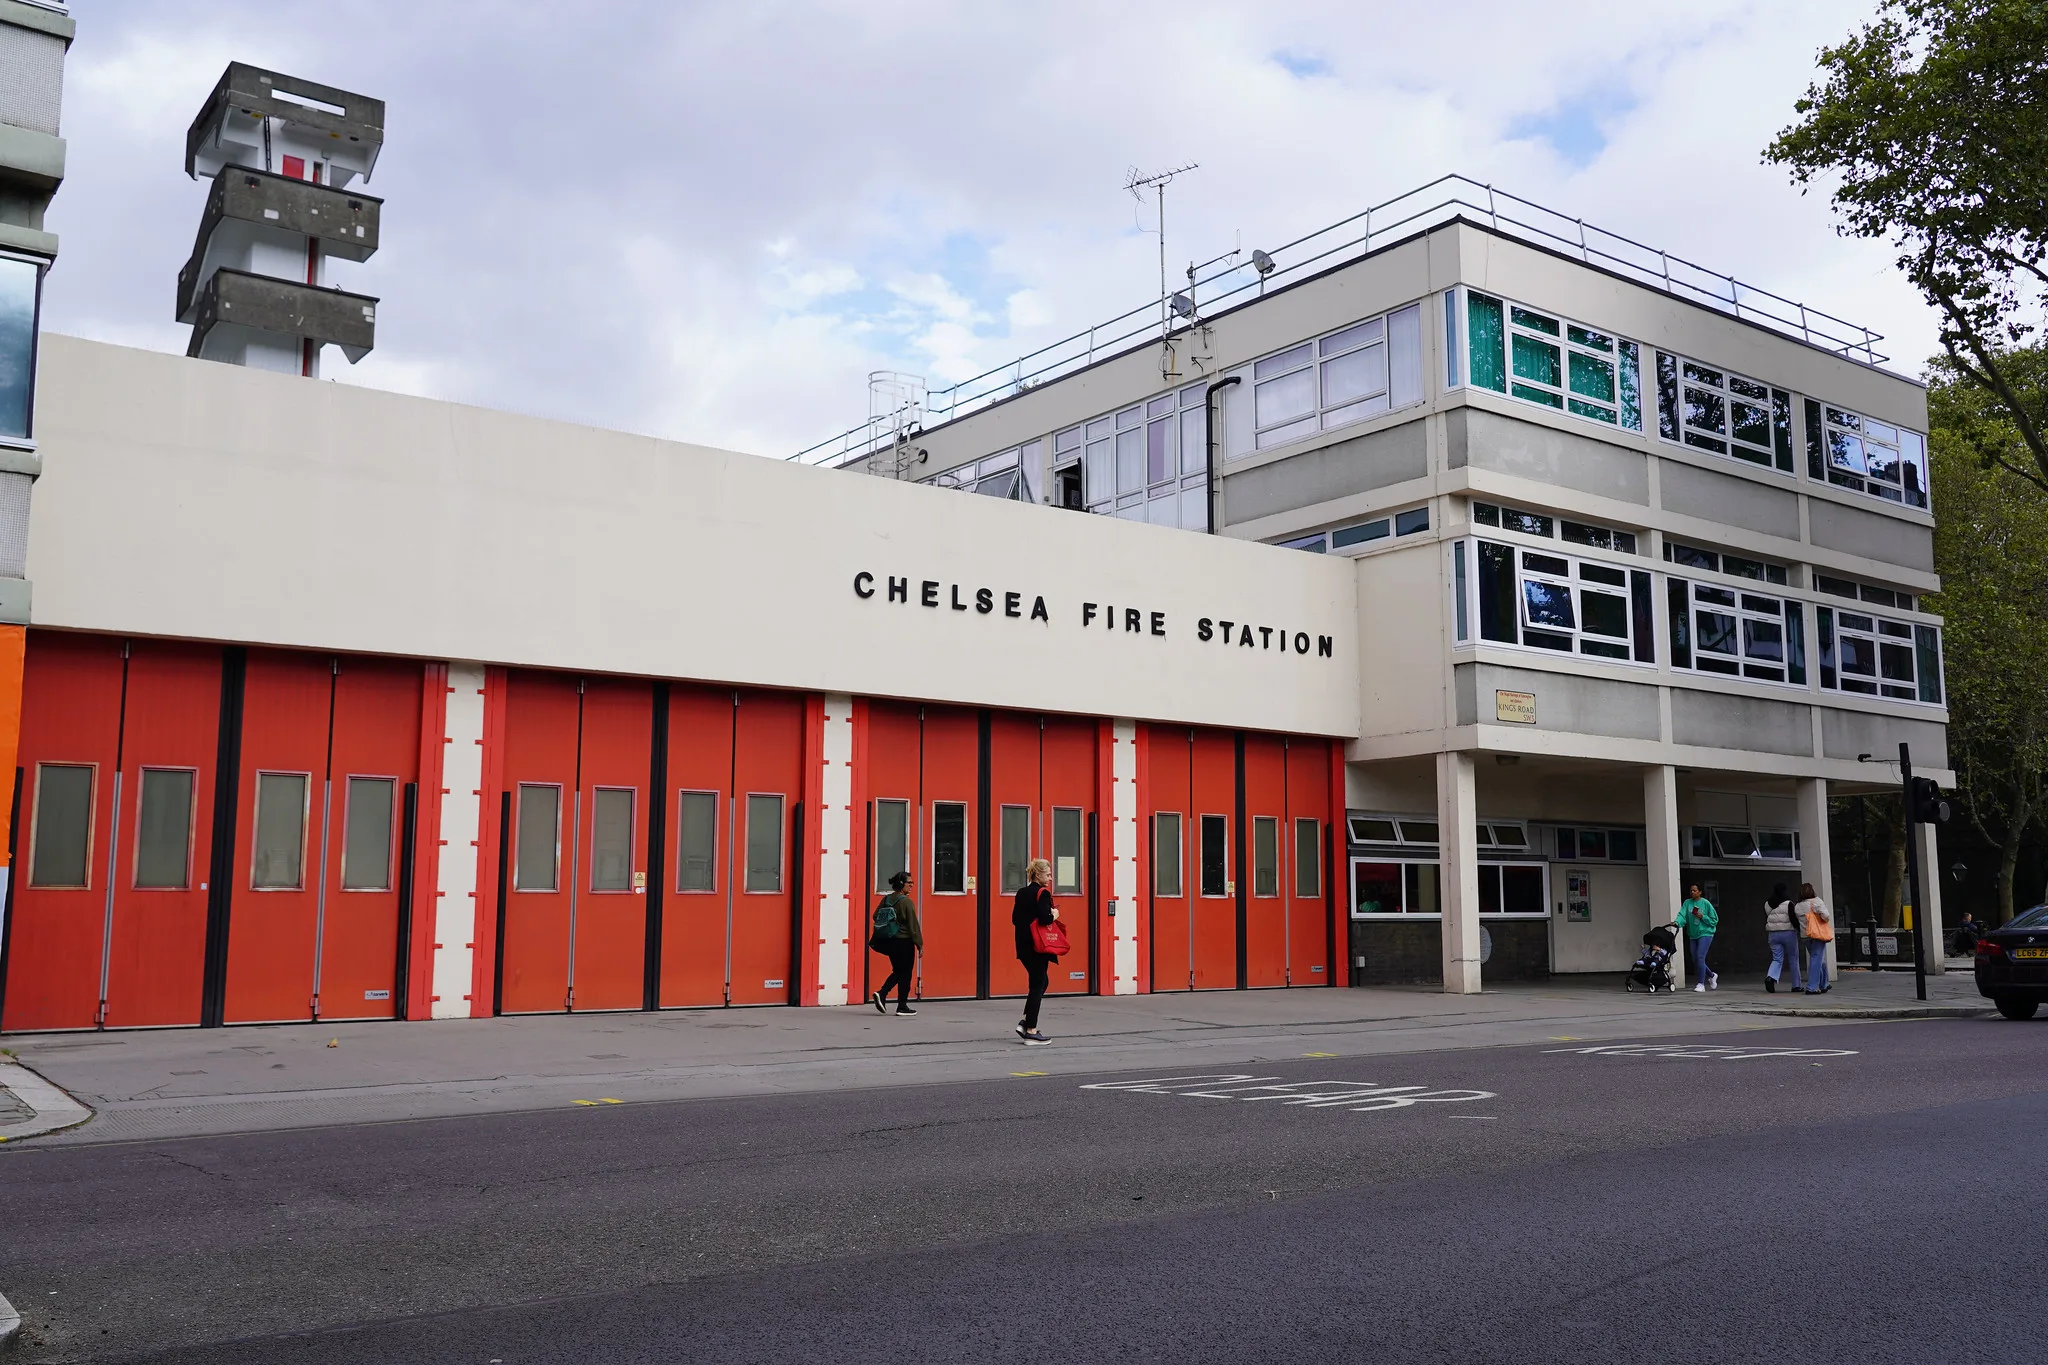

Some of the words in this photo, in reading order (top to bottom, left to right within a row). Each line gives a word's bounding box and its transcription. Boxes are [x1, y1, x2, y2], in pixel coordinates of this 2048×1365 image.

[853, 571, 1048, 621] CHELSEA
[1082, 602, 1166, 636] FIRE
[1198, 617, 1333, 657] STATION
[1498, 703, 1516, 712] KINGS
[1518, 705, 1534, 714] ROAD
[1523, 714, 1534, 722] SW3
[1540, 1044, 1859, 1059] KEEP
[1079, 1074, 1498, 1111] CLEAR
